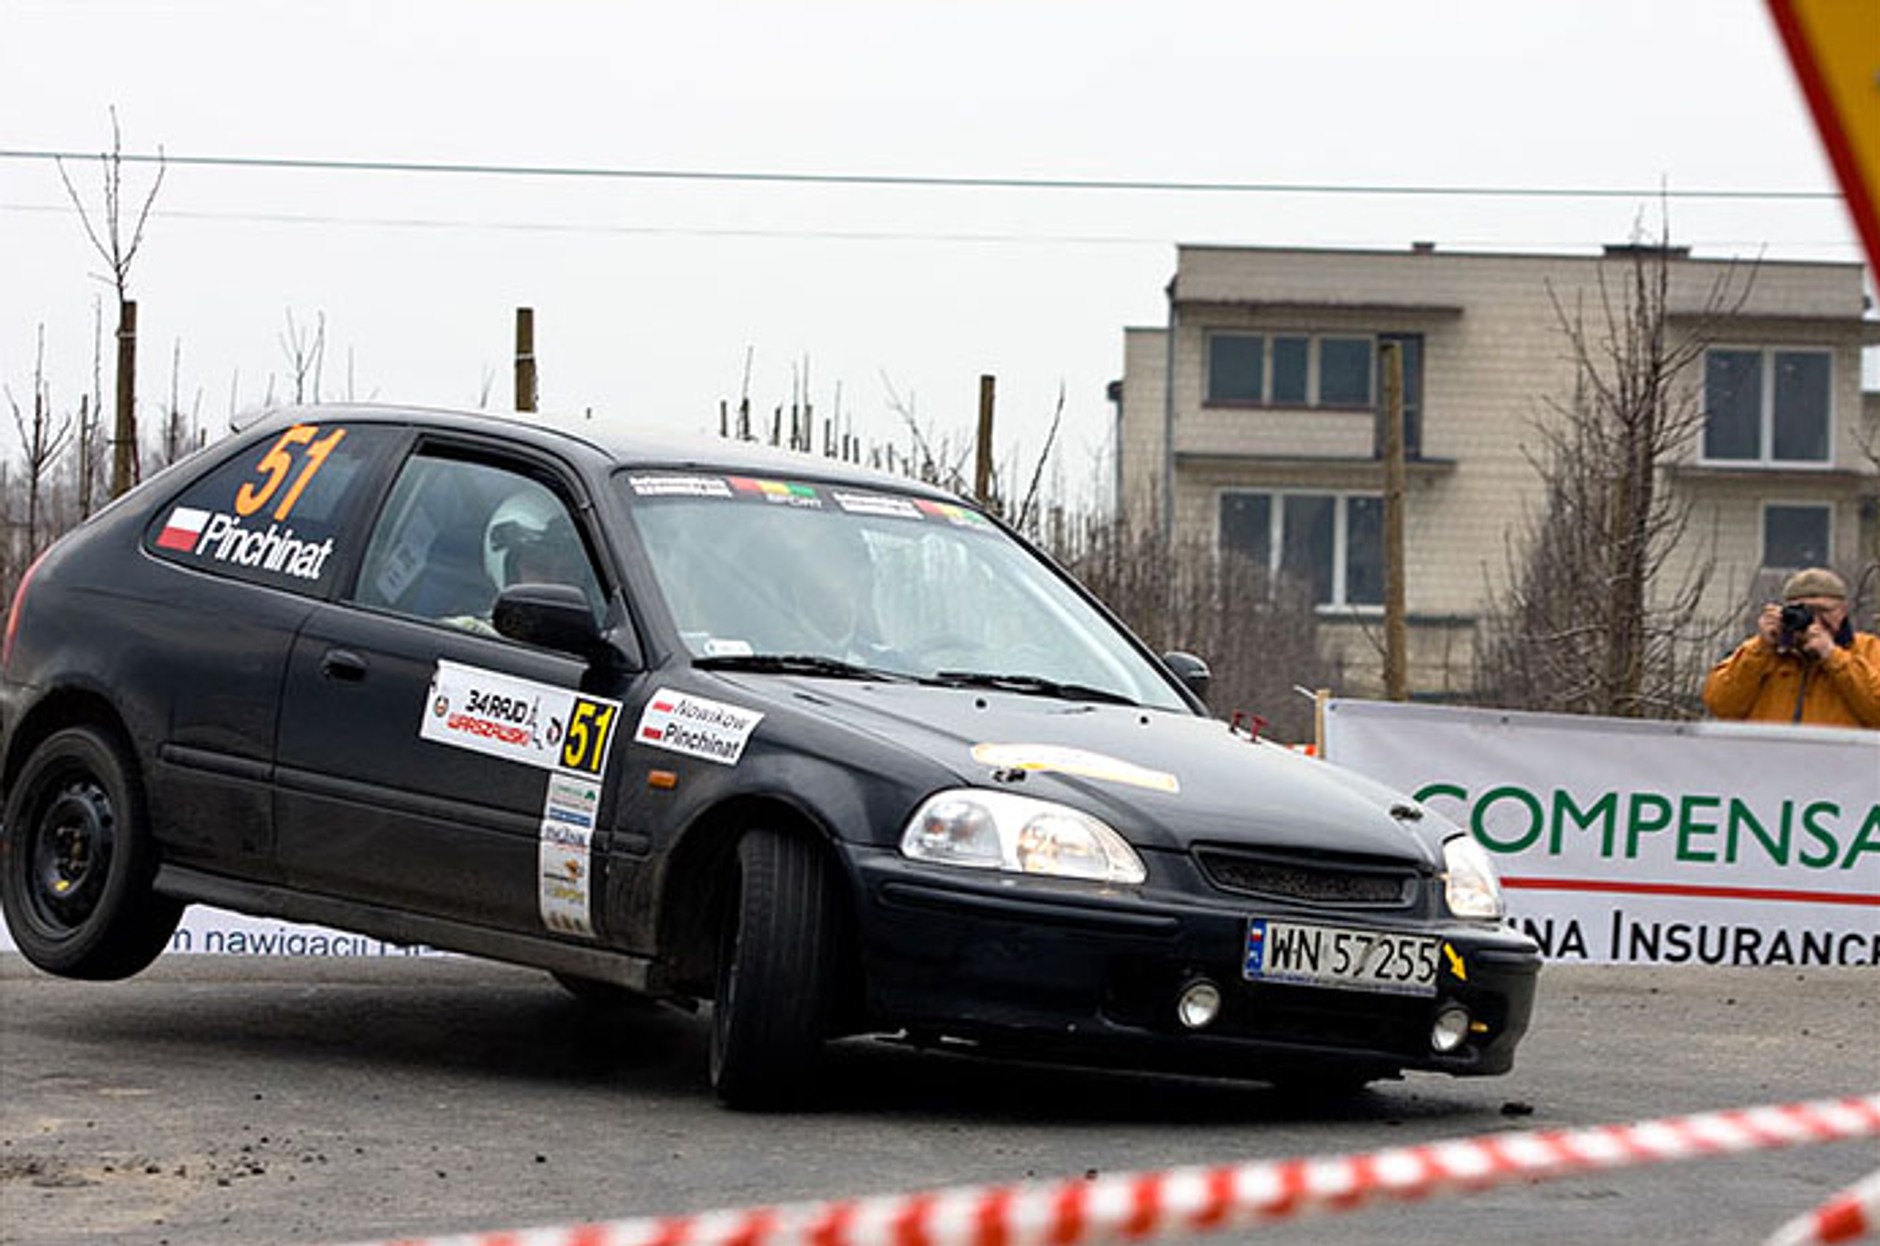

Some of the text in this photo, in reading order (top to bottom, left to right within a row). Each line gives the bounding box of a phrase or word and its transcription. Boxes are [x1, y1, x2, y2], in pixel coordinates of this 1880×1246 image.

[235, 423, 347, 522] 51
[195, 513, 334, 580] Pinchinat
[564, 703, 614, 772] 51
[663, 722, 740, 759] Pinchinat
[1270, 928, 1438, 983] WN 57255
